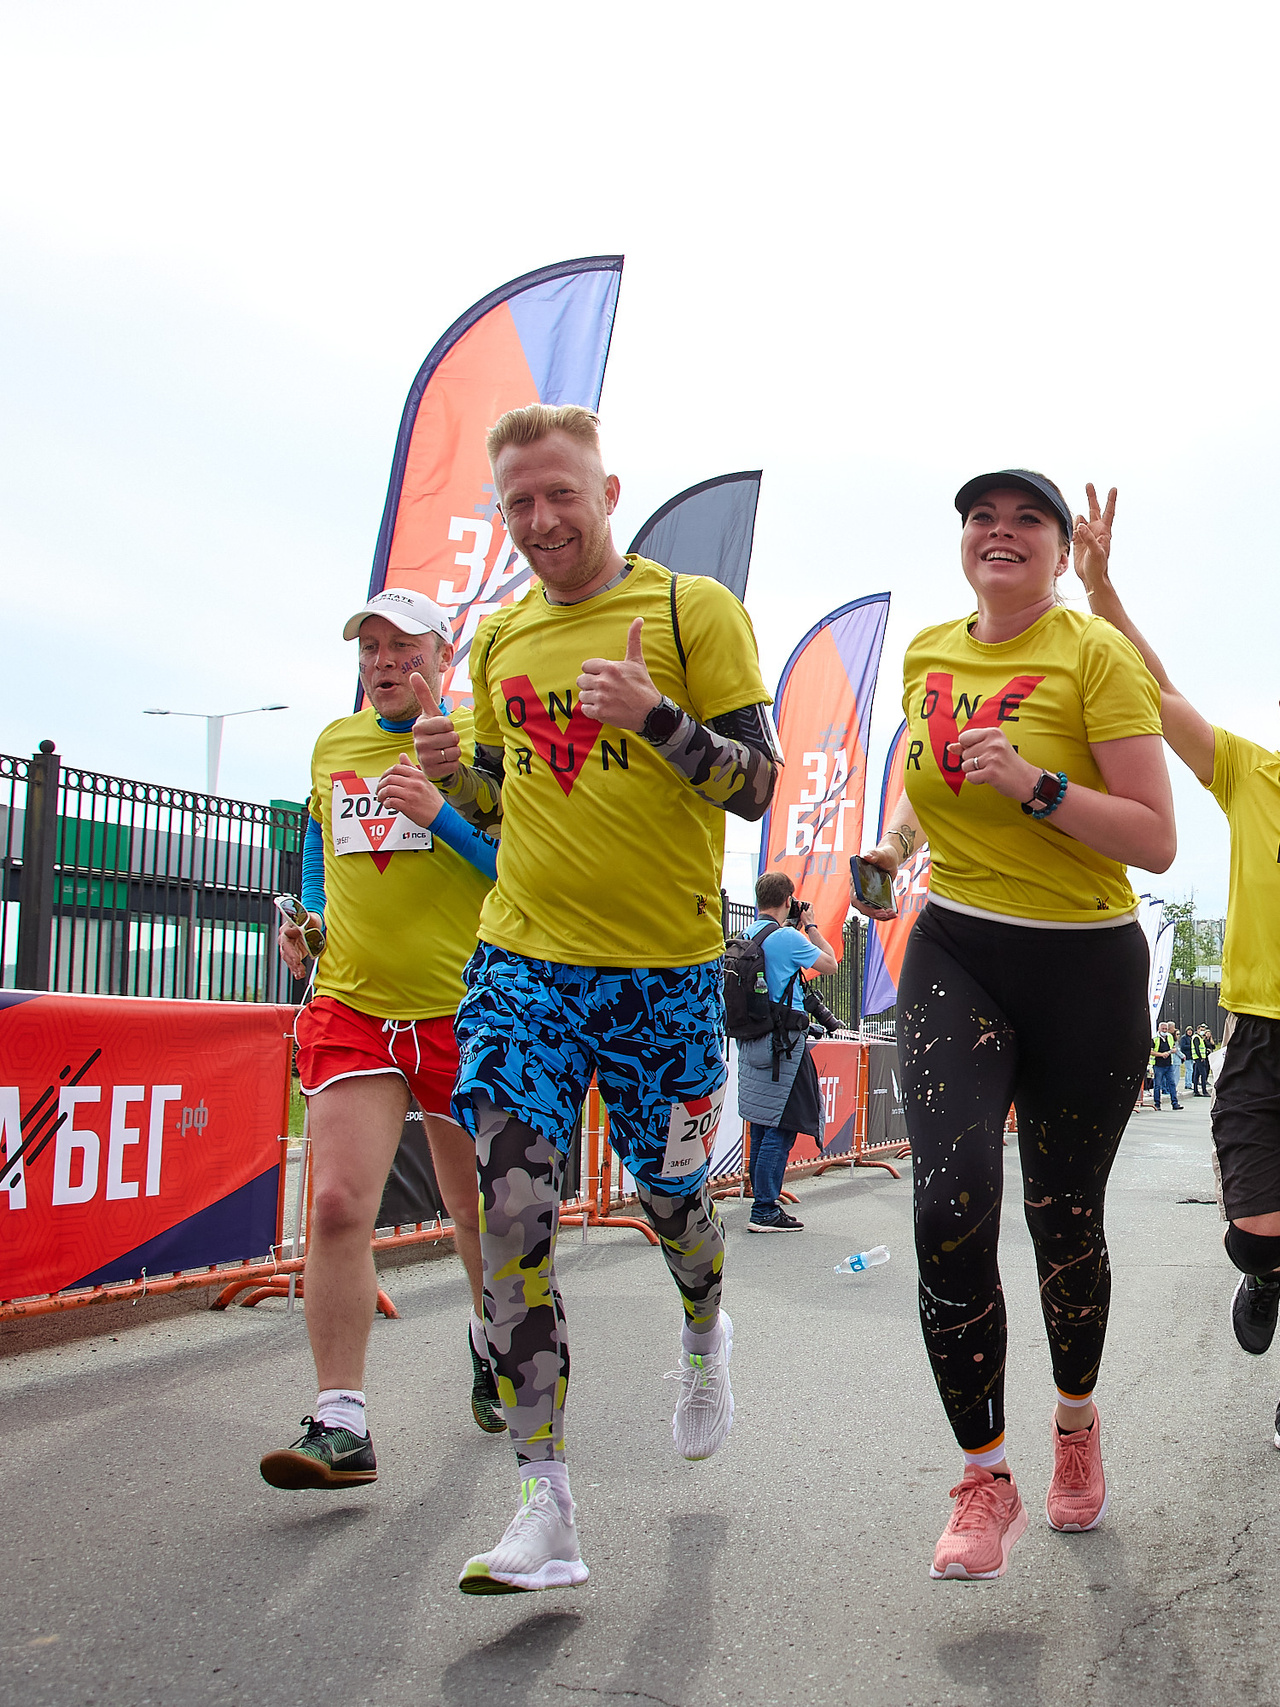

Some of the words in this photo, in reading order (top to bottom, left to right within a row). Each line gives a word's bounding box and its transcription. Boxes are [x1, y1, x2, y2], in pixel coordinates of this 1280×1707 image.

[505, 689, 574, 728] ON
[920, 690, 1025, 722] ONE
[515, 738, 629, 776] RUN
[800, 748, 849, 804] ЗА
[369, 824, 386, 837] 10
[785, 800, 855, 856] БЕГ
